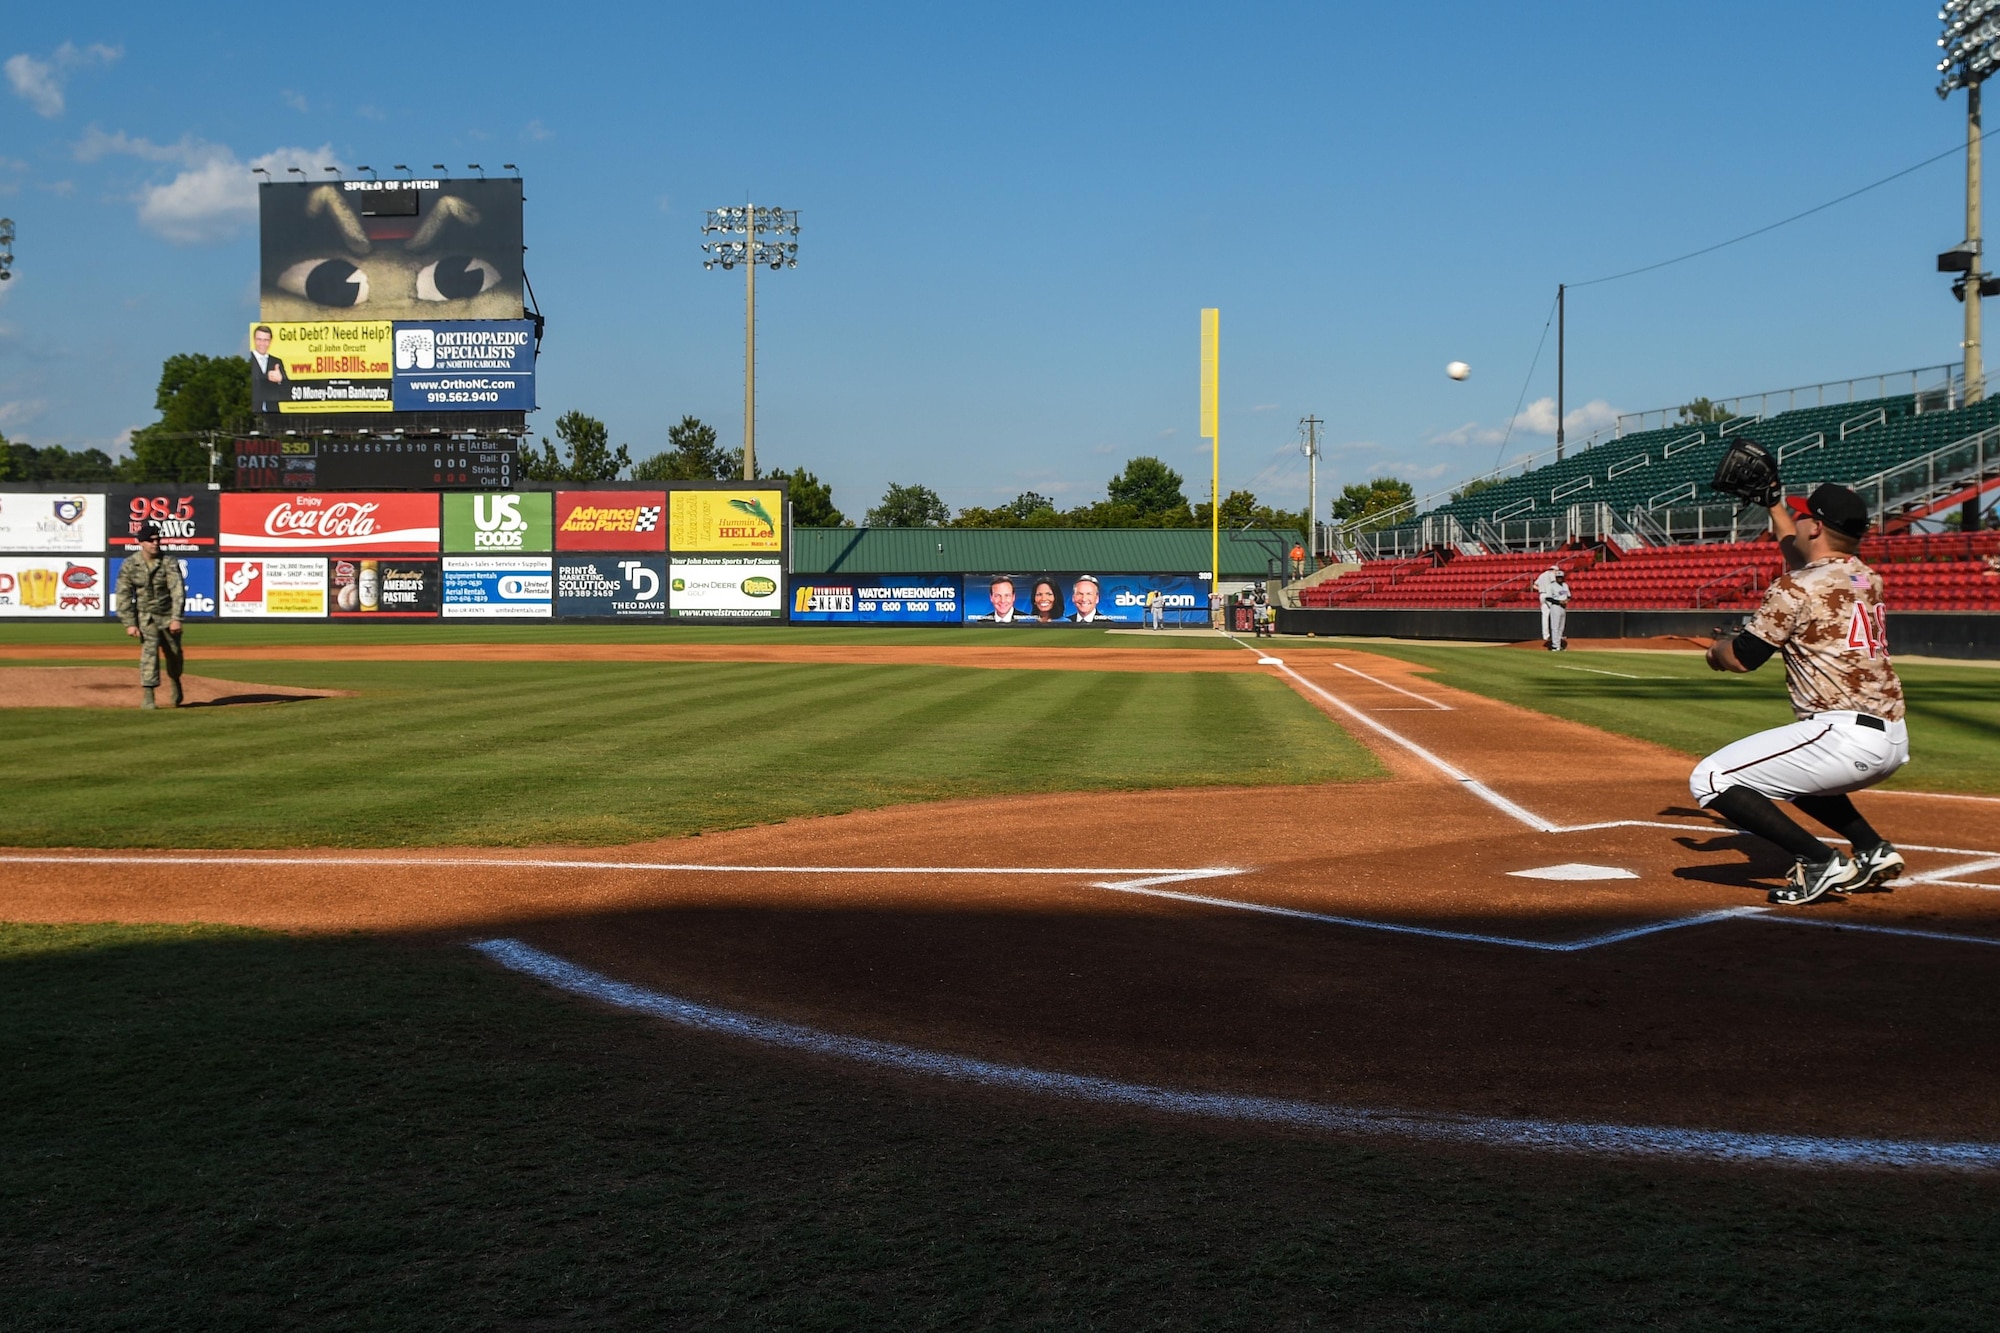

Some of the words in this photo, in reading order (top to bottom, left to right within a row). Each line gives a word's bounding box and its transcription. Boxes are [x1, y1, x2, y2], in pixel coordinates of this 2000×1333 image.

[385, 181, 400, 190] OF
[403, 180, 440, 190] PITCH
[280, 328, 296, 341] Got
[300, 327, 328, 340] Debt?
[333, 326, 358, 340] Need
[362, 326, 390, 342] Help?
[436, 332, 528, 345] ORTHOPAEDIC
[324, 344, 341, 352] John
[436, 346, 515, 359] SPECIALISTS
[292, 356, 389, 374] www.BillsBills.com
[446, 360, 473, 368] NORTH
[474, 360, 511, 368] CAROLINA
[410, 380, 515, 390] www.OrthoNC.com
[350, 386, 389, 401] Bankruptcy
[428, 392, 498, 402] 919.562.9410
[282, 442, 309, 454] 5:50
[434, 444, 441, 452] R
[447, 444, 454, 452] H
[460, 444, 466, 452] E
[237, 455, 278, 468] CATS
[434, 459, 441, 468] 0
[448, 459, 455, 468] 0
[459, 459, 466, 468] 0
[480, 454, 498, 462] Ball:
[501, 453, 510, 464] 0
[472, 465, 498, 474] Strike:
[501, 465, 510, 475] 0
[481, 477, 498, 485] Out:
[501, 476, 510, 487] 0
[297, 496, 322, 507] Enjoy
[130, 496, 195, 520] 98.5
[474, 494, 528, 531] US.
[568, 506, 634, 520] Advance
[264, 502, 379, 536] Coca-Cola
[560, 520, 595, 531] Auto
[595, 520, 631, 531] Parts
[475, 531, 522, 546] FOODS
[719, 528, 774, 538] HELLes
[224, 562, 259, 601] ASC
[383, 580, 423, 590] AMERICA'S
[559, 581, 620, 590] SOLUTIONS
[383, 592, 418, 602] PASTIME.
[858, 588, 891, 598] WATCH
[892, 588, 955, 598] WEEKNIGHTS
[820, 597, 850, 610] NEWS
[858, 602, 876, 611] 5:00
[882, 602, 900, 611] 6:00
[906, 602, 929, 611] 10:00
[935, 602, 956, 611] 11:00
